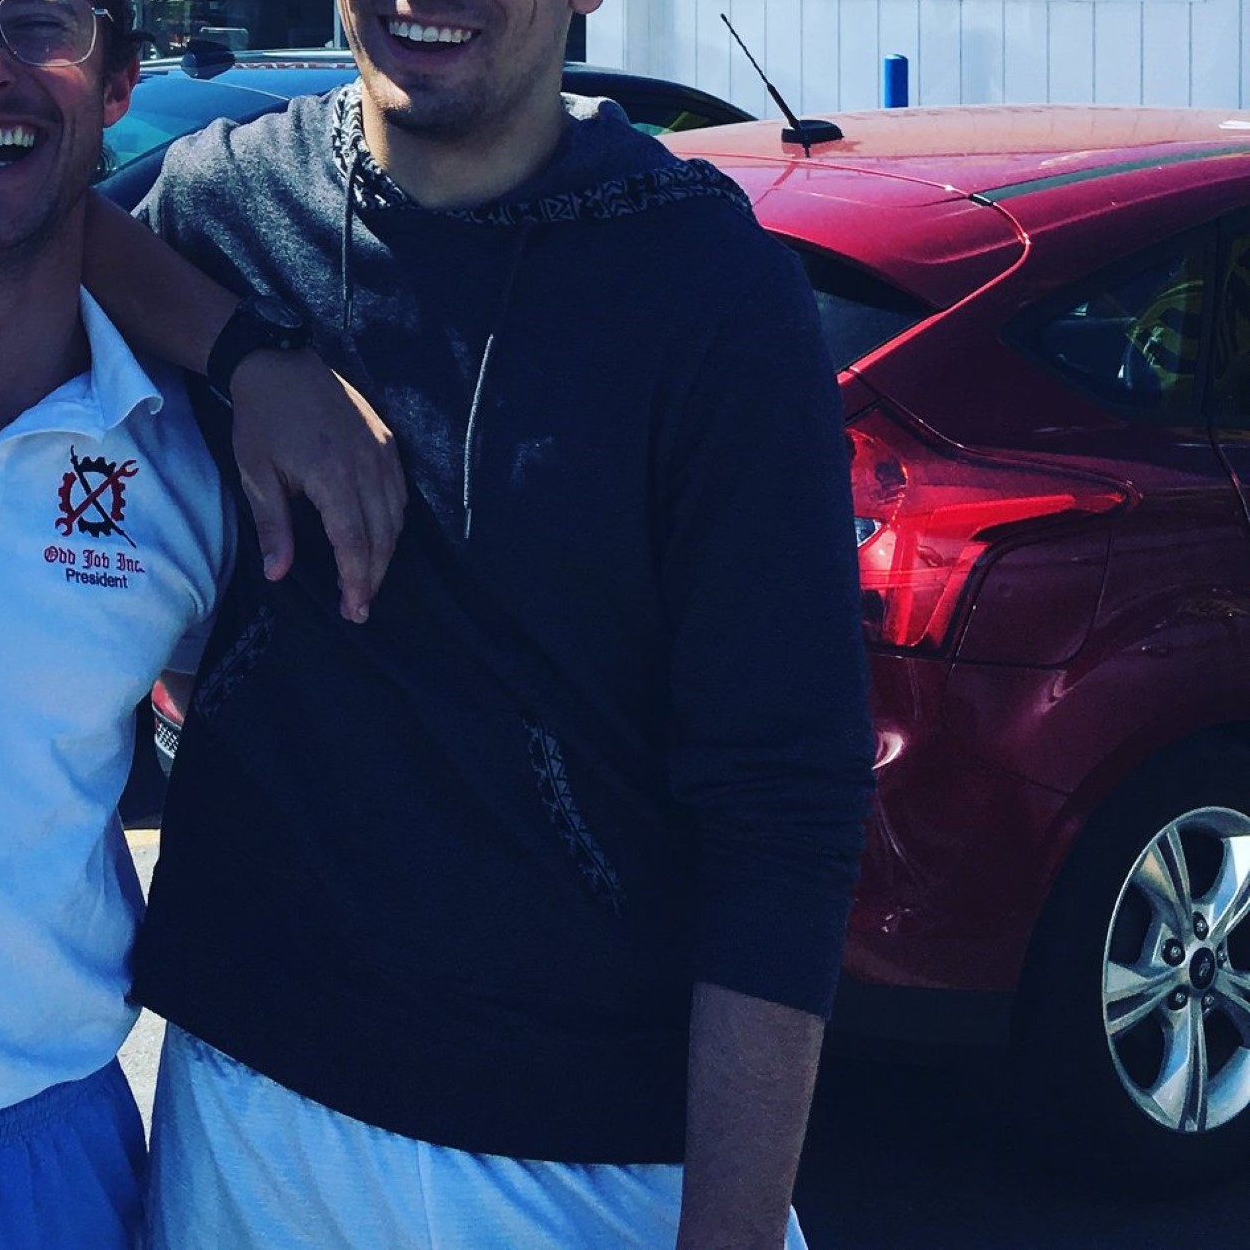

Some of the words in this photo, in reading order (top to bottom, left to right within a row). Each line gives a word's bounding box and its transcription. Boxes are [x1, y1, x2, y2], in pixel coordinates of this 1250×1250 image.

[44, 545, 76, 565] Odd
[82, 549, 110, 569] Job
[65, 568, 129, 589] President
